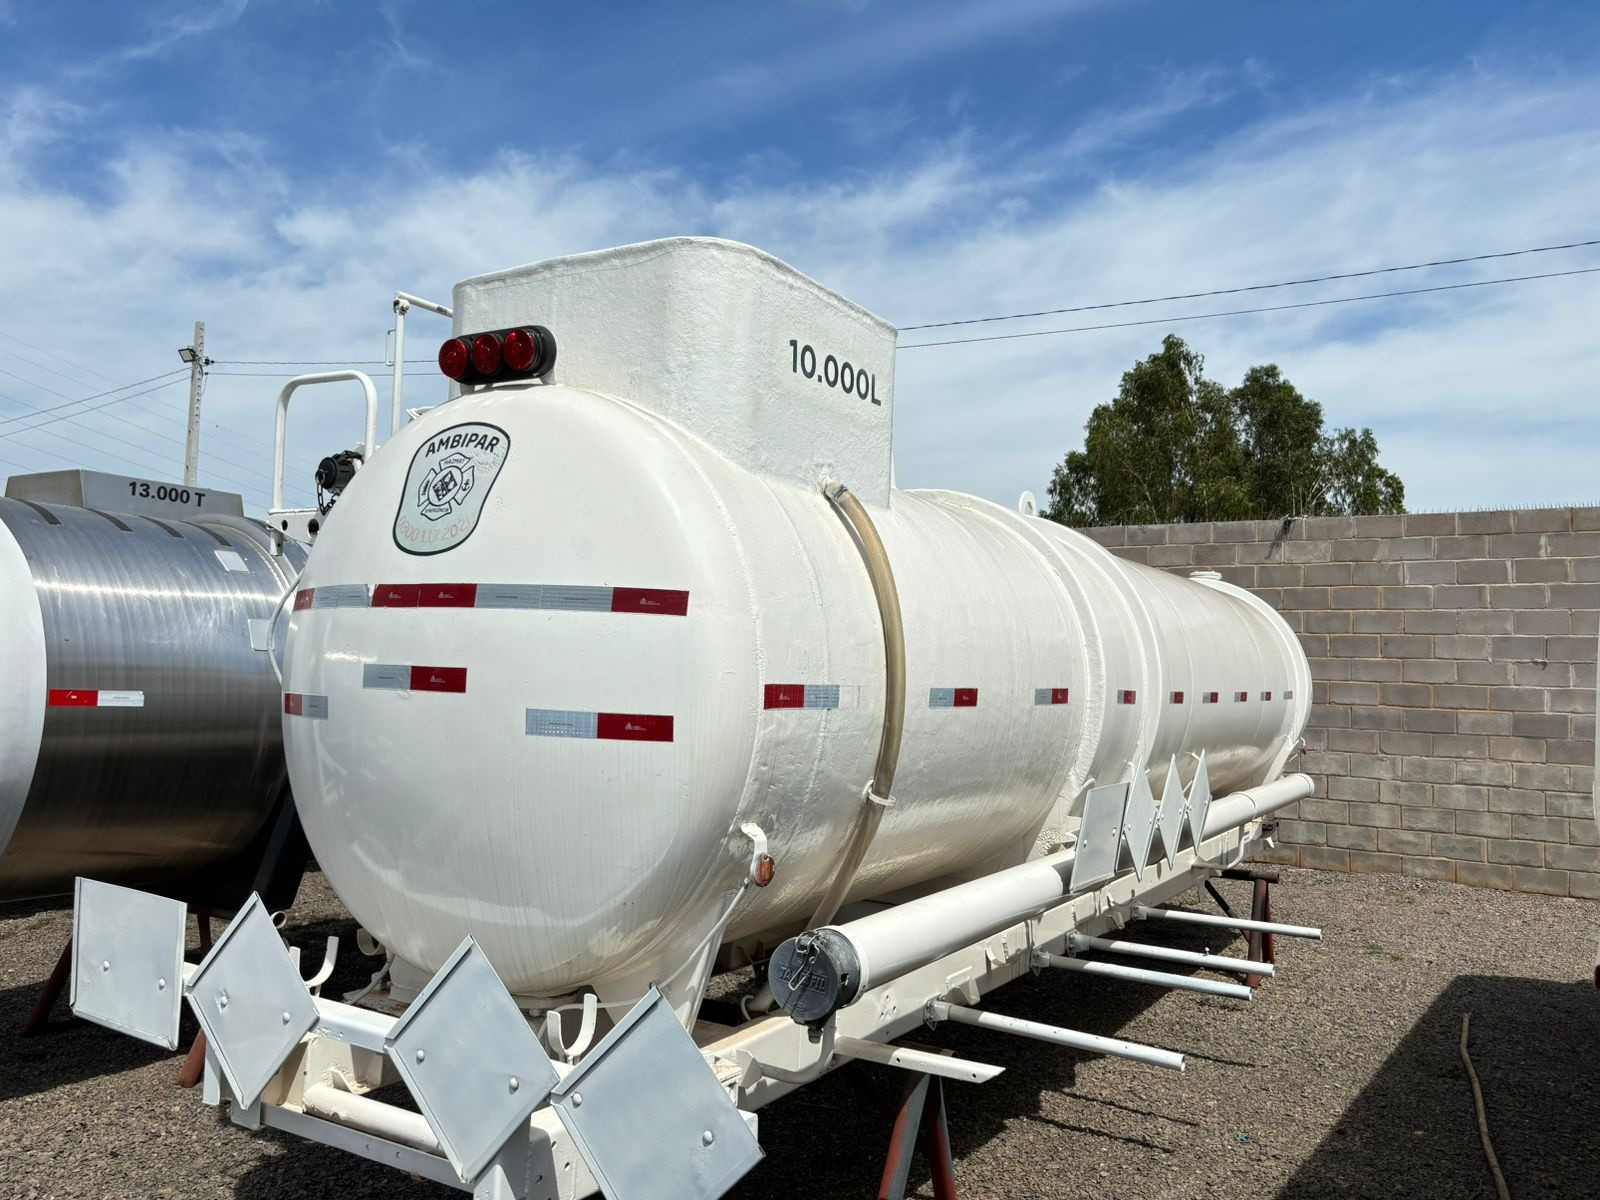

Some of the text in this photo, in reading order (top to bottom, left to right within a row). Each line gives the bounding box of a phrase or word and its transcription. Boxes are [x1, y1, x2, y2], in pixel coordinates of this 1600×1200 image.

[789, 339, 881, 407] 10.000L
[425, 433, 500, 458] AMBIPAR
[129, 481, 206, 507] 13.000 T
